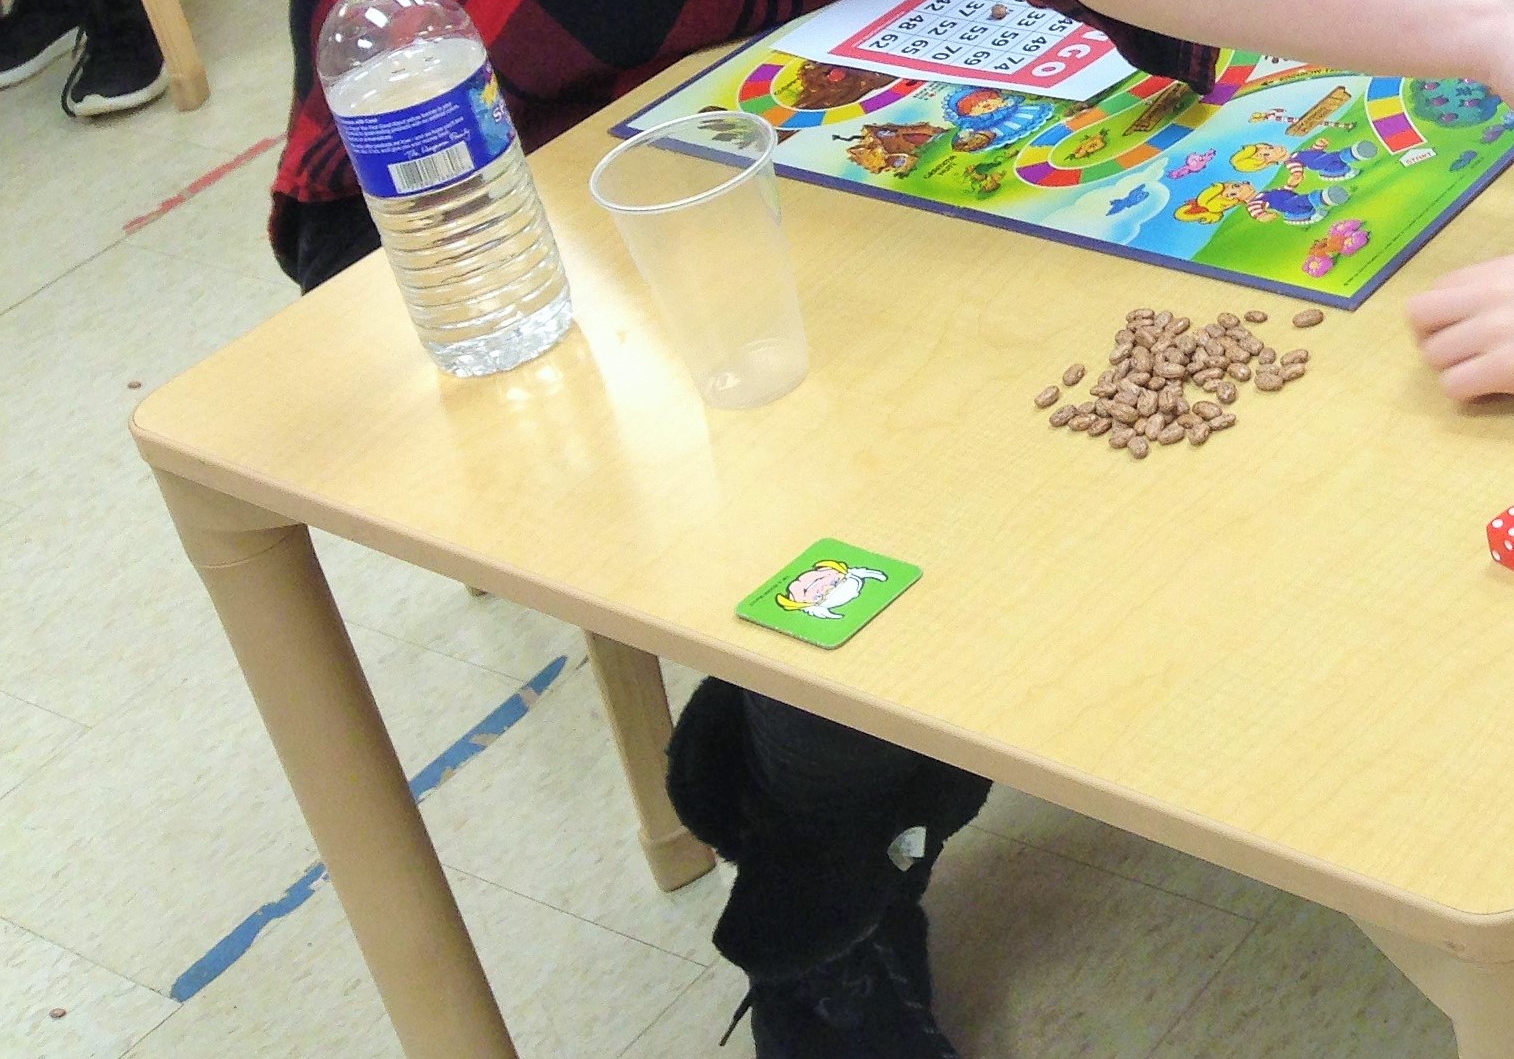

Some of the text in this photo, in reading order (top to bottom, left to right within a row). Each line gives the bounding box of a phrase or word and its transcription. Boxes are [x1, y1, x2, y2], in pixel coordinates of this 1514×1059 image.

[958, 1, 985, 17] 37
[898, 14, 925, 30] 48
[927, 20, 958, 36] 52
[959, 25, 989, 41] 53
[963, 10, 1046, 66] 33 59 69
[868, 34, 899, 49] 62
[901, 39, 929, 55] 65
[994, 18, 1074, 72] 45 49 74
[931, 45, 963, 61] 70
